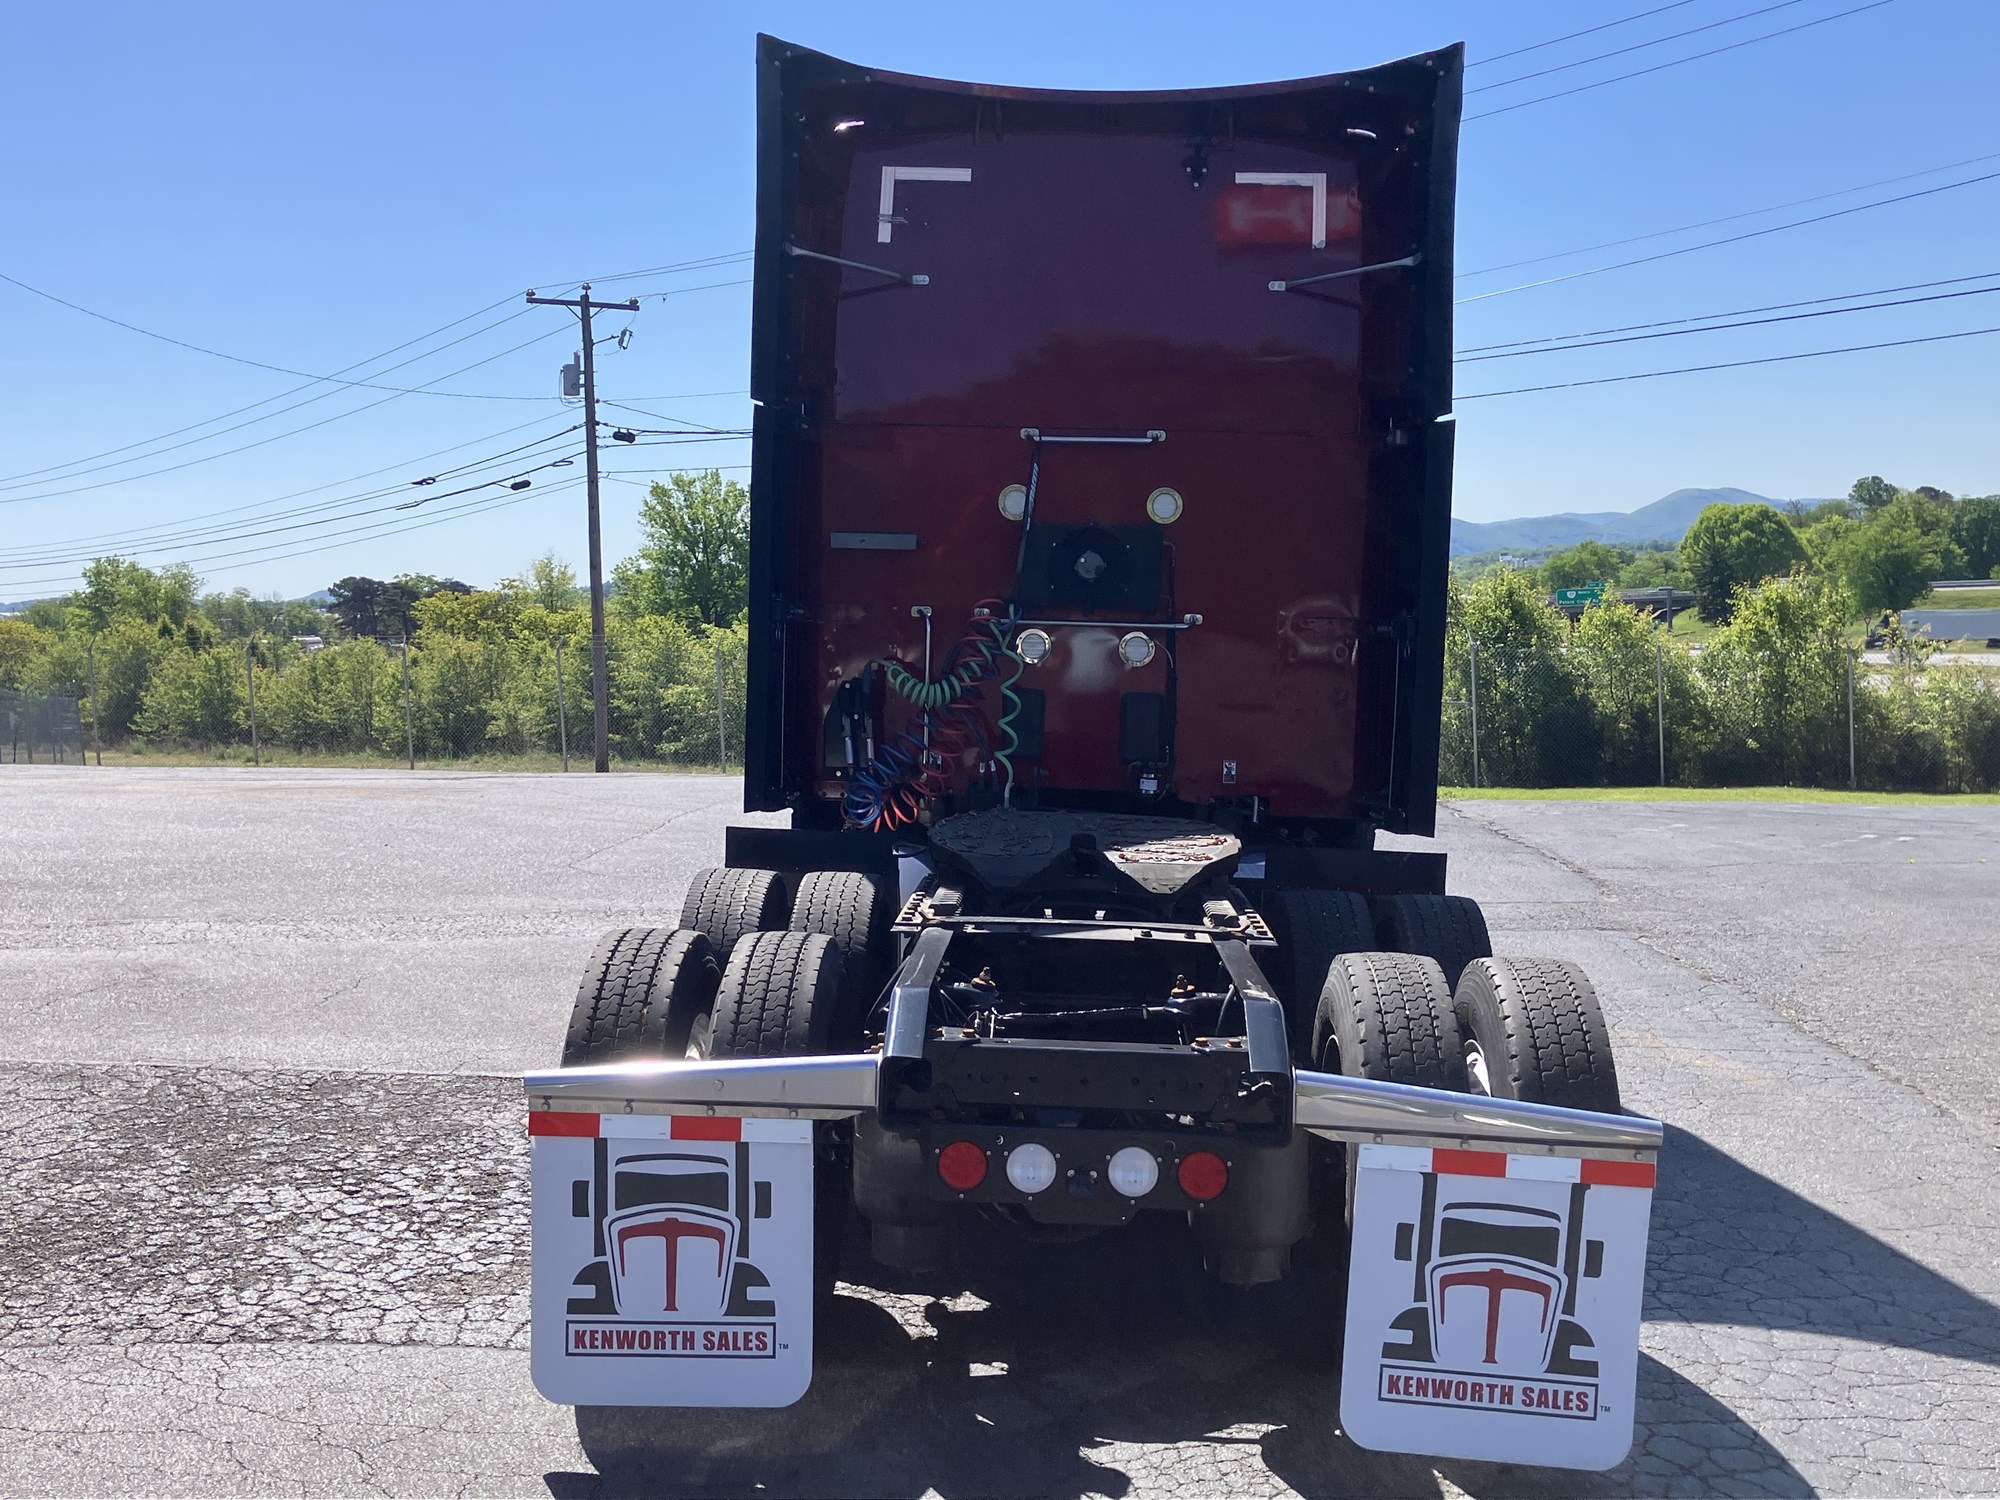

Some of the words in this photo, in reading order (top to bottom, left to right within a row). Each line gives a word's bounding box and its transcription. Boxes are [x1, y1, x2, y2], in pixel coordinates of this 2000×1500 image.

[574, 1329, 696, 1351] KENWORTH
[703, 1331, 768, 1352] SALES
[1387, 1374, 1515, 1406] KENWORTH
[1521, 1386, 1589, 1413] SALES
